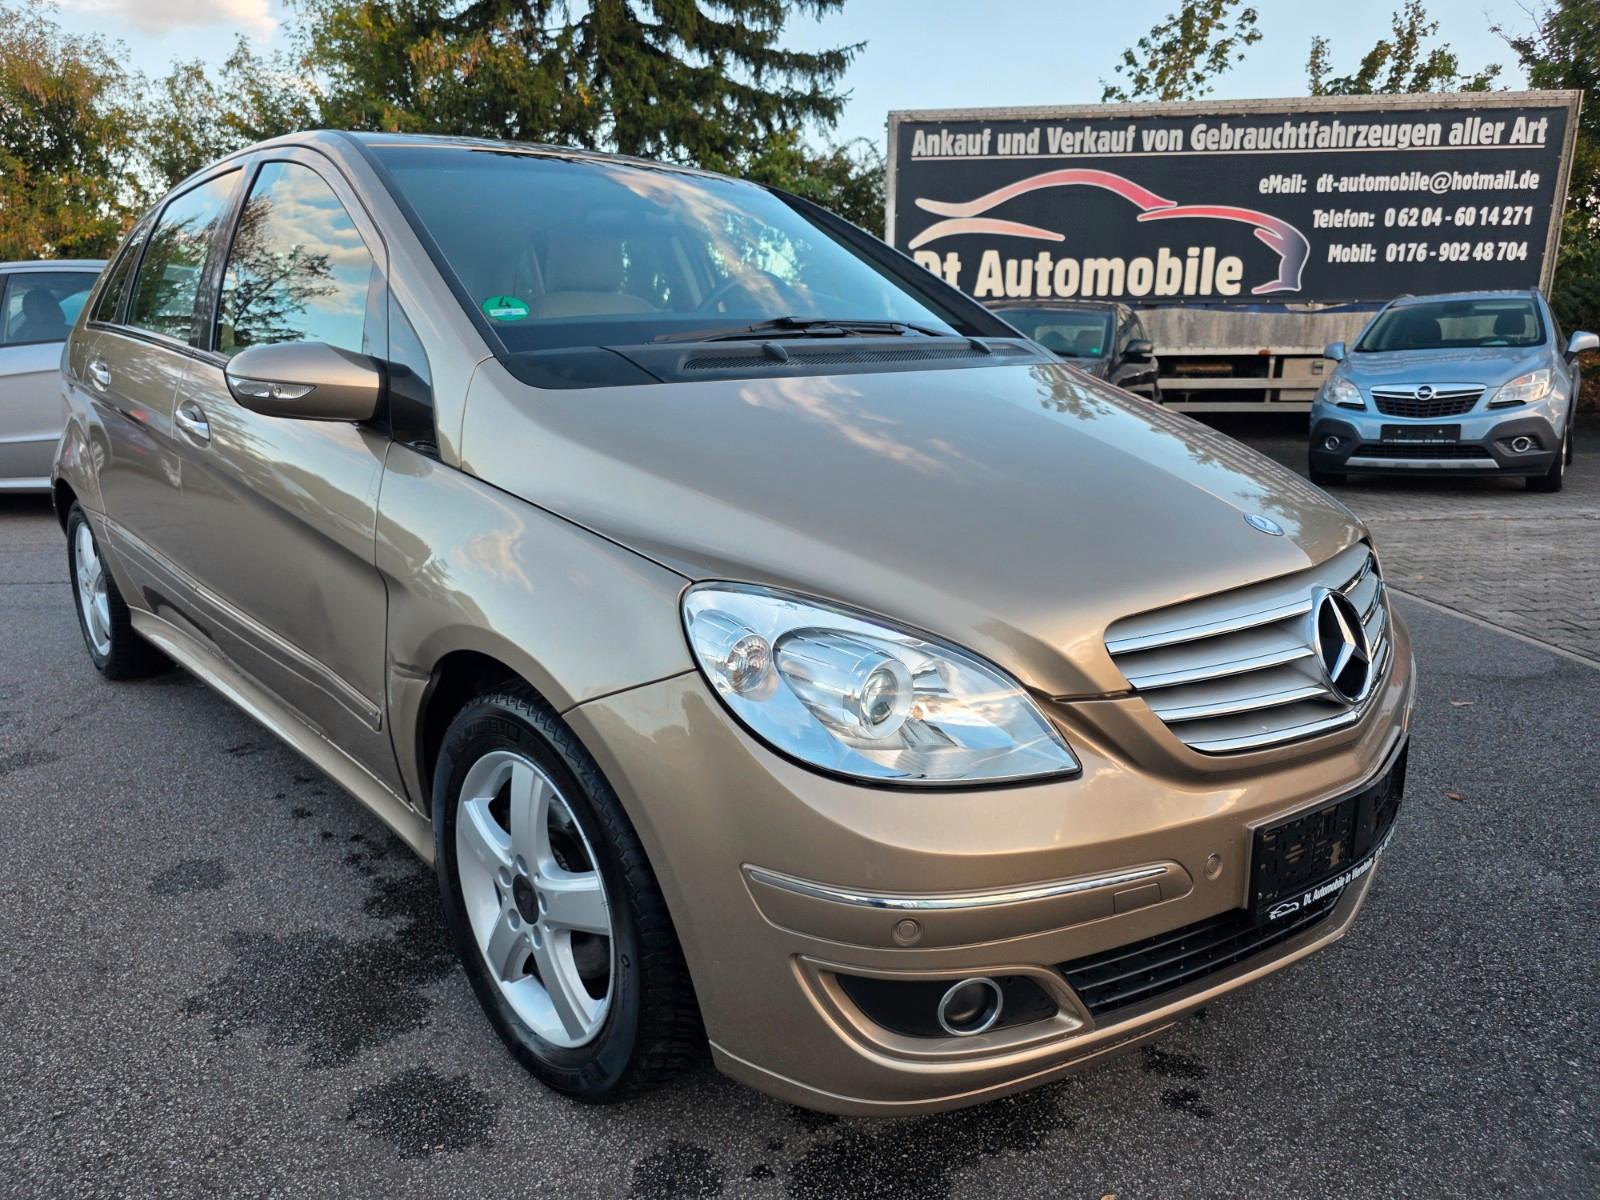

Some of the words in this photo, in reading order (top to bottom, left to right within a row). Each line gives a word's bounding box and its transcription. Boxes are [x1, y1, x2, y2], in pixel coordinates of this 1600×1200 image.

[911, 127, 991, 157] Ankauf
[997, 126, 1041, 155] und
[1046, 123, 1137, 154] Verkauf
[1141, 127, 1184, 152] von
[1189, 118, 1443, 151] Gebrauchtfahrzeugen
[1448, 116, 1506, 145] aller
[1508, 115, 1550, 144] Art
[1258, 174, 1307, 194] eMail:
[1316, 169, 1540, 195] dt-automobile@hotmail.de
[1312, 208, 1375, 229] Telefon:
[1327, 243, 1377, 263] Mobil:
[973, 246, 1244, 298] Automobile
[499, 297, 512, 308] 4
